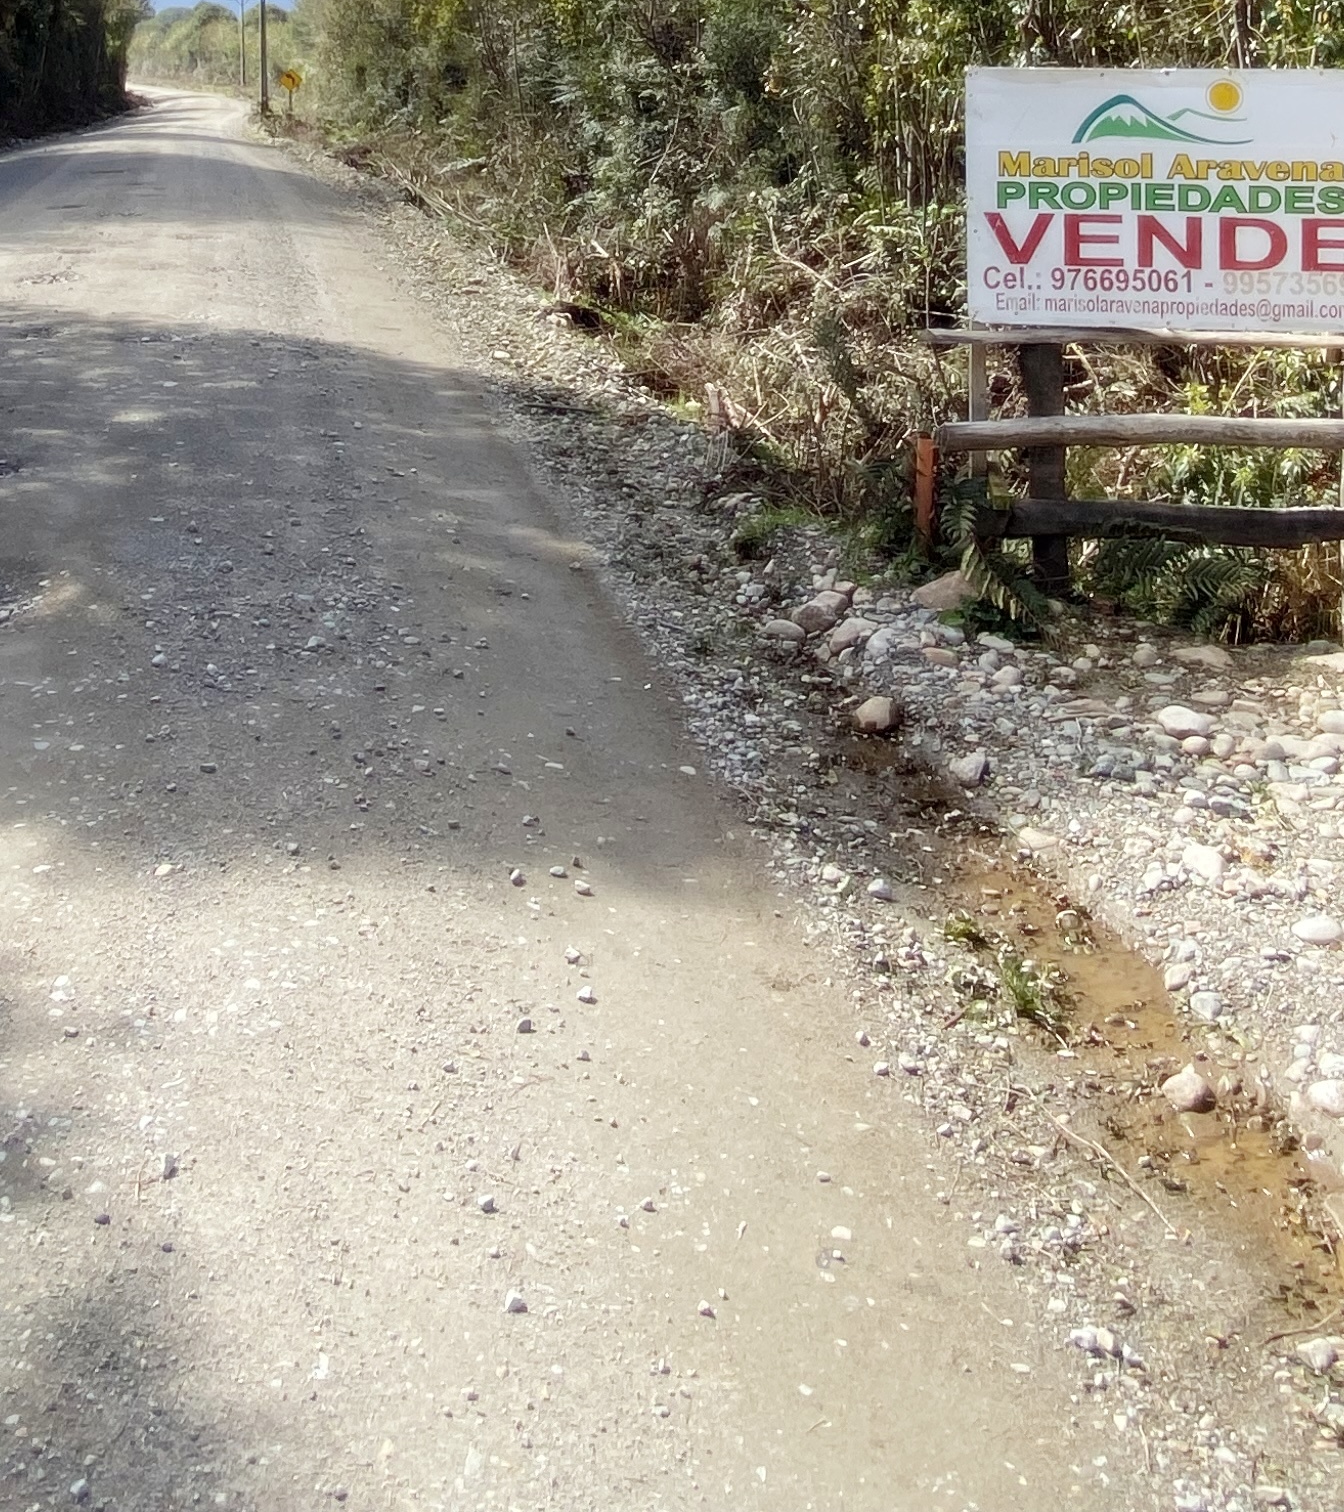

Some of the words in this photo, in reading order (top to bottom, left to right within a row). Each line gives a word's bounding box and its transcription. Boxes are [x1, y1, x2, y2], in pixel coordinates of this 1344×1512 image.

[998, 151, 1153, 178] Marisol
[983, 267, 1041, 290] Cel.:
[1051, 268, 1193, 293] 976695061
[996, 293, 1040, 312] Email:
